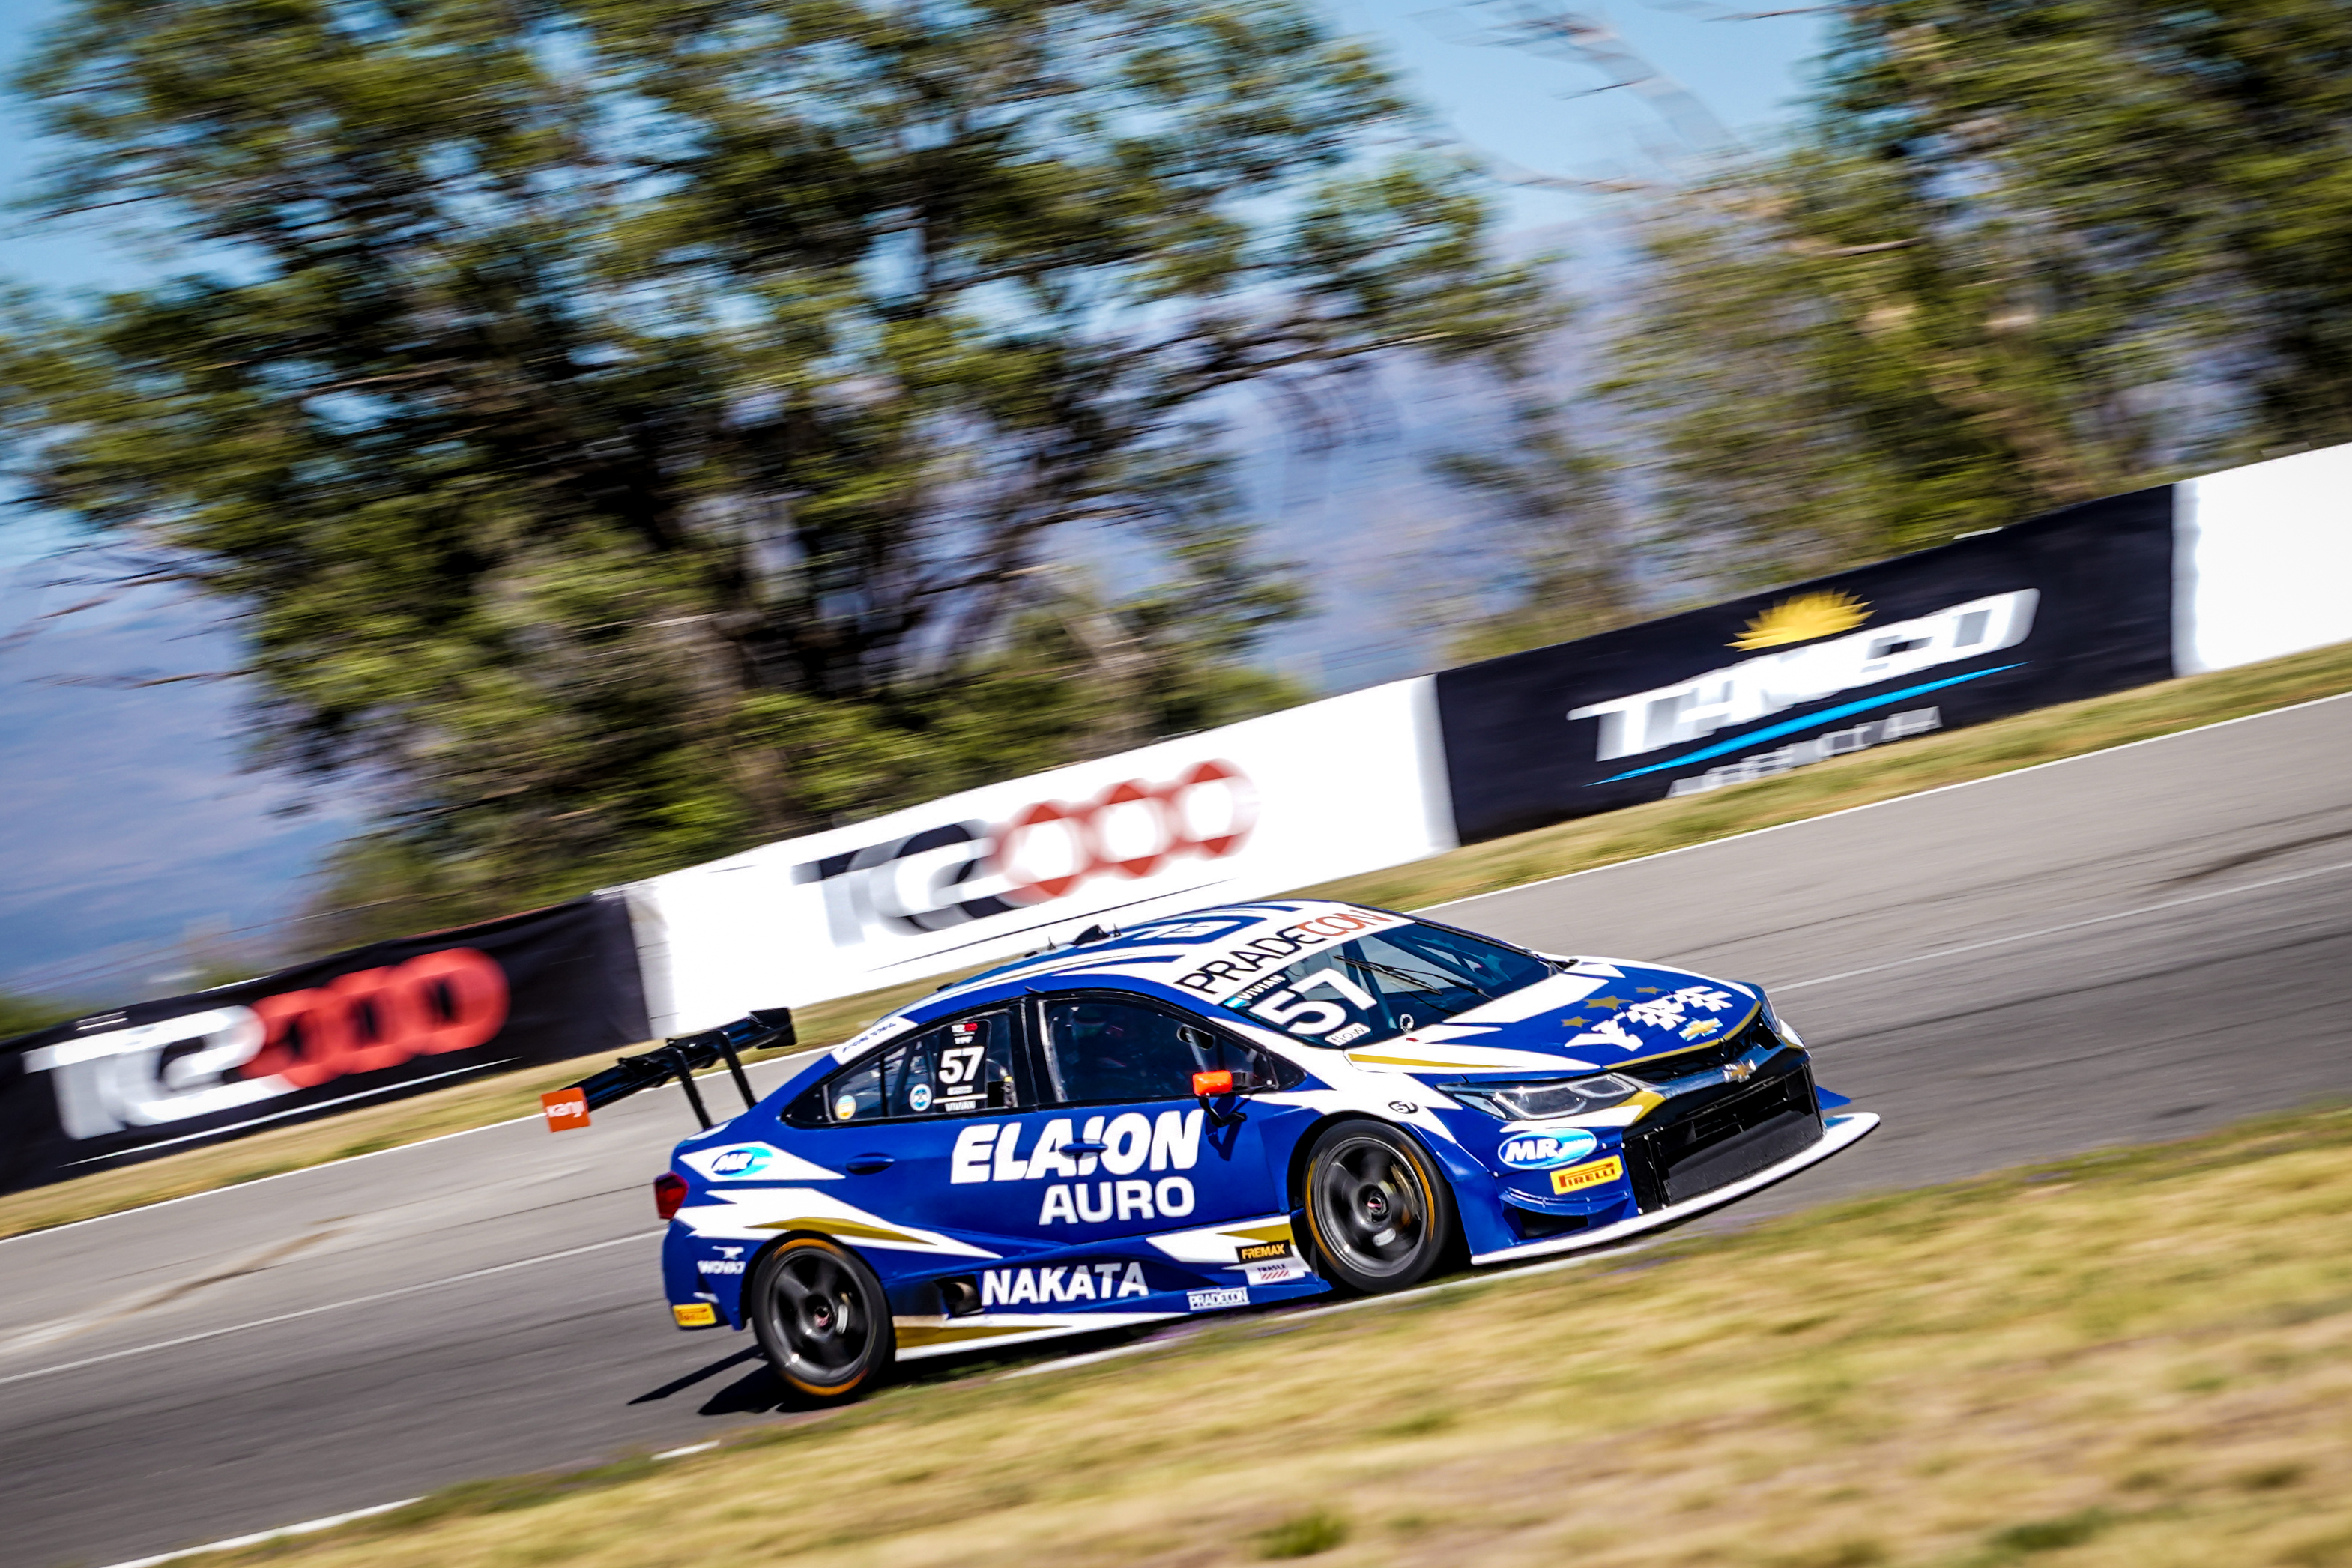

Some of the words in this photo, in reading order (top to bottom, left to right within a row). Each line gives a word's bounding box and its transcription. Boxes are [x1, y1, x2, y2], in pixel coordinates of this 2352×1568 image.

[791, 758, 1260, 947] TC2000
[1173, 909, 1393, 994] PRADECON
[1237, 975, 1286, 1000] VIVIAN
[1248, 968, 1377, 1035] 57
[22, 947, 511, 1140] TC2000
[938, 1046, 985, 1084] 57
[1390, 1101, 1415, 1114] 57
[951, 1110, 1205, 1184] ELAION
[1558, 1163, 1615, 1188] PIRELLI
[1039, 1176, 1195, 1226] AURO
[1241, 1244, 1285, 1260] FREMAX
[982, 1262, 1149, 1307] NAKATA
[1188, 1289, 1247, 1307] PRADECON
